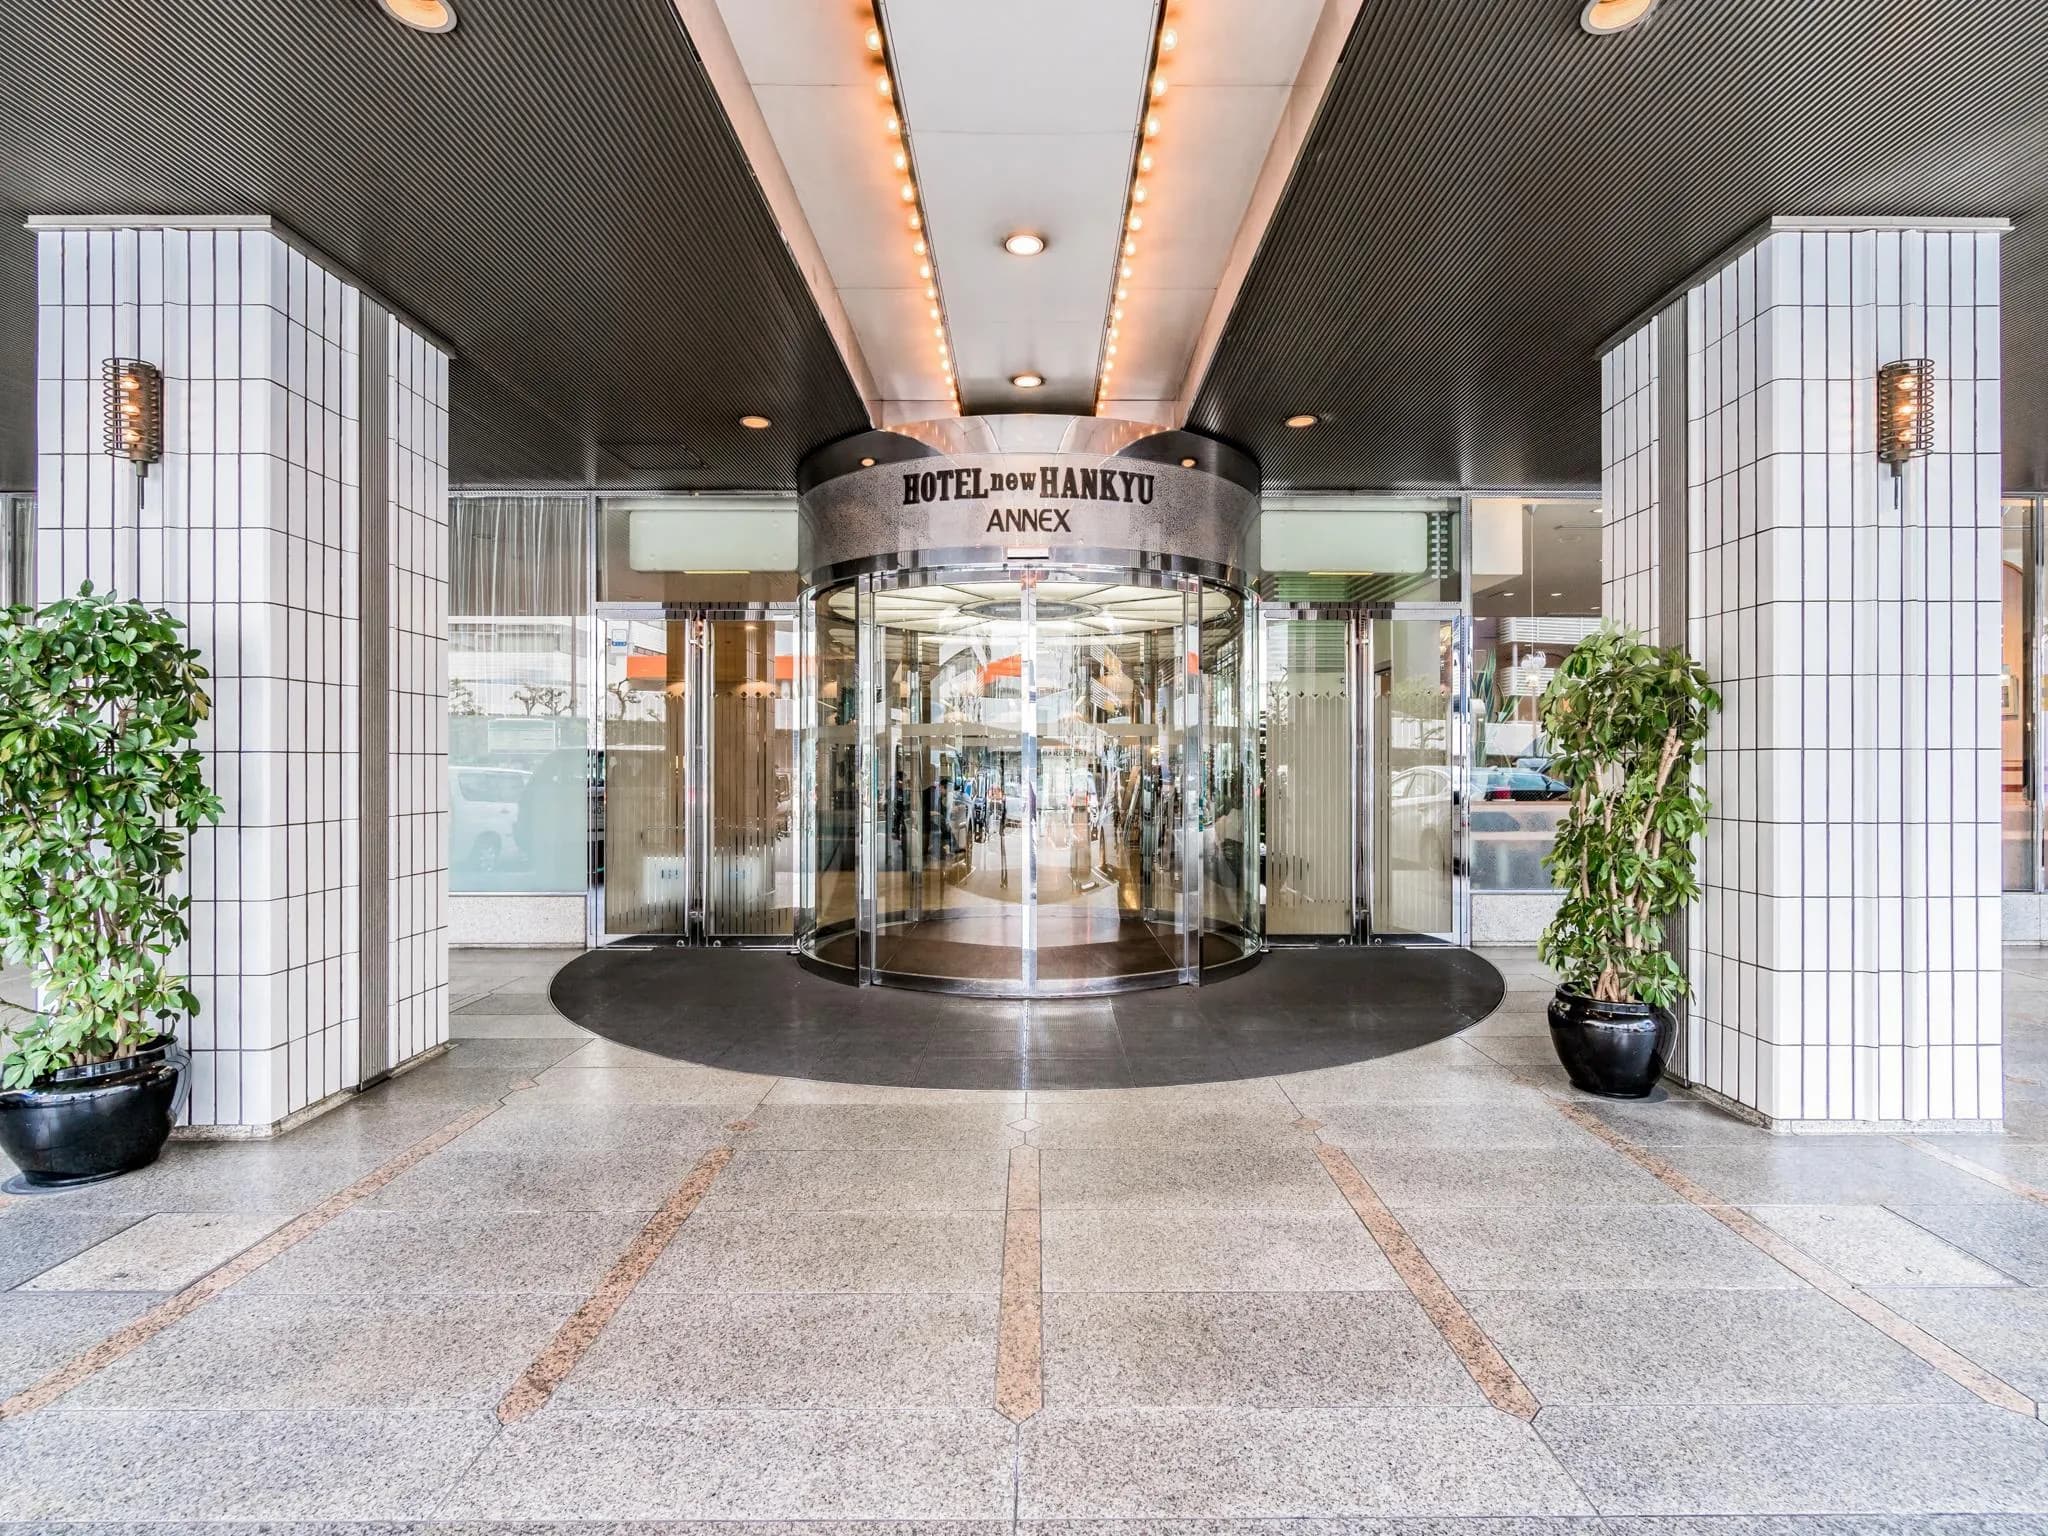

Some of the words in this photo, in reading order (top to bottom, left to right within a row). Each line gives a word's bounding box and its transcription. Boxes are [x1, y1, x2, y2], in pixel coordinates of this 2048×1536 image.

[903, 468, 988, 505] HOTEL
[990, 472, 1036, 491] new
[1039, 467, 1155, 505] HANKYU
[986, 508, 1072, 532] ANNEX
